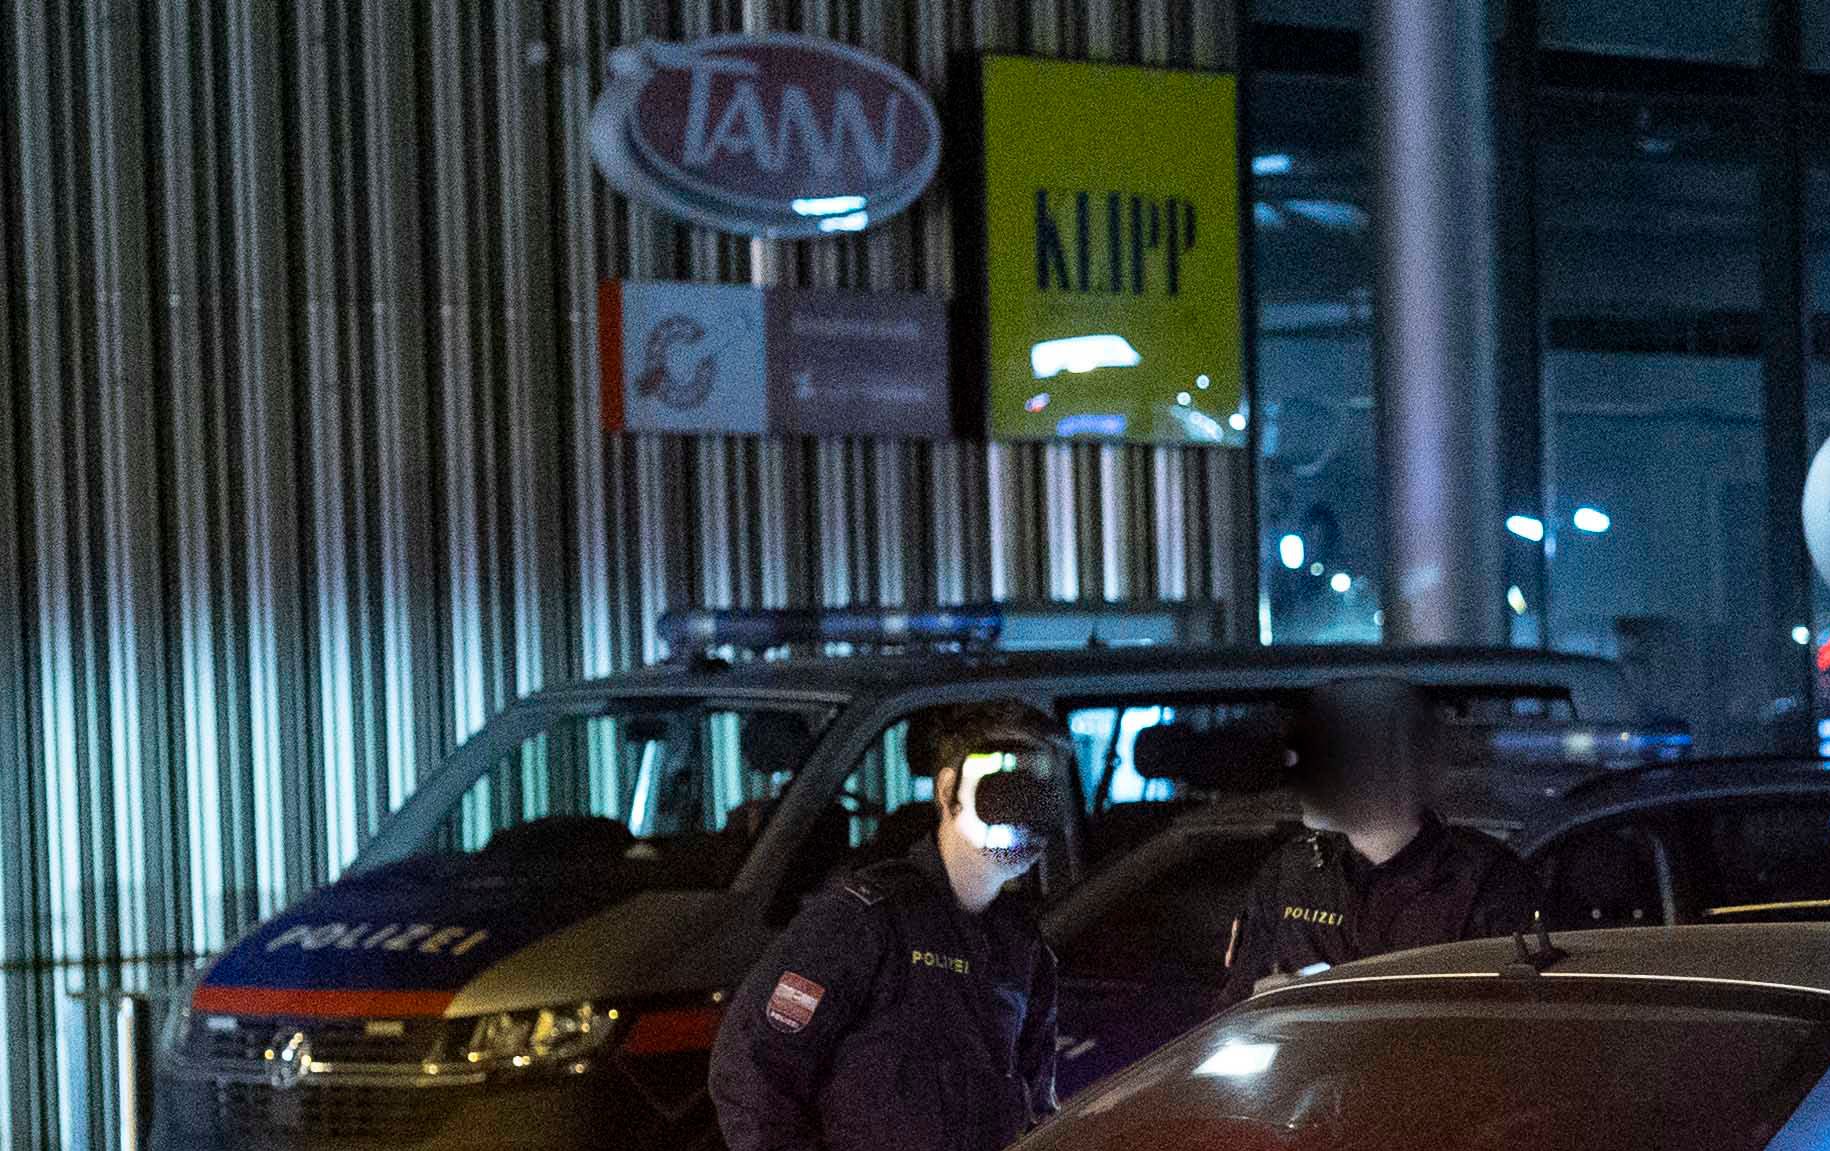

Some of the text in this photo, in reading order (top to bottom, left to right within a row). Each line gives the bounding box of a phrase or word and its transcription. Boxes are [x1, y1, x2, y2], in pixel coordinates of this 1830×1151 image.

[674, 57, 899, 177] TANN
[1034, 187, 1197, 297] KLIPP
[1283, 905, 1344, 926] POLIZEI
[265, 922, 488, 956] POLIZEI
[911, 950, 970, 975] POLIZEI
